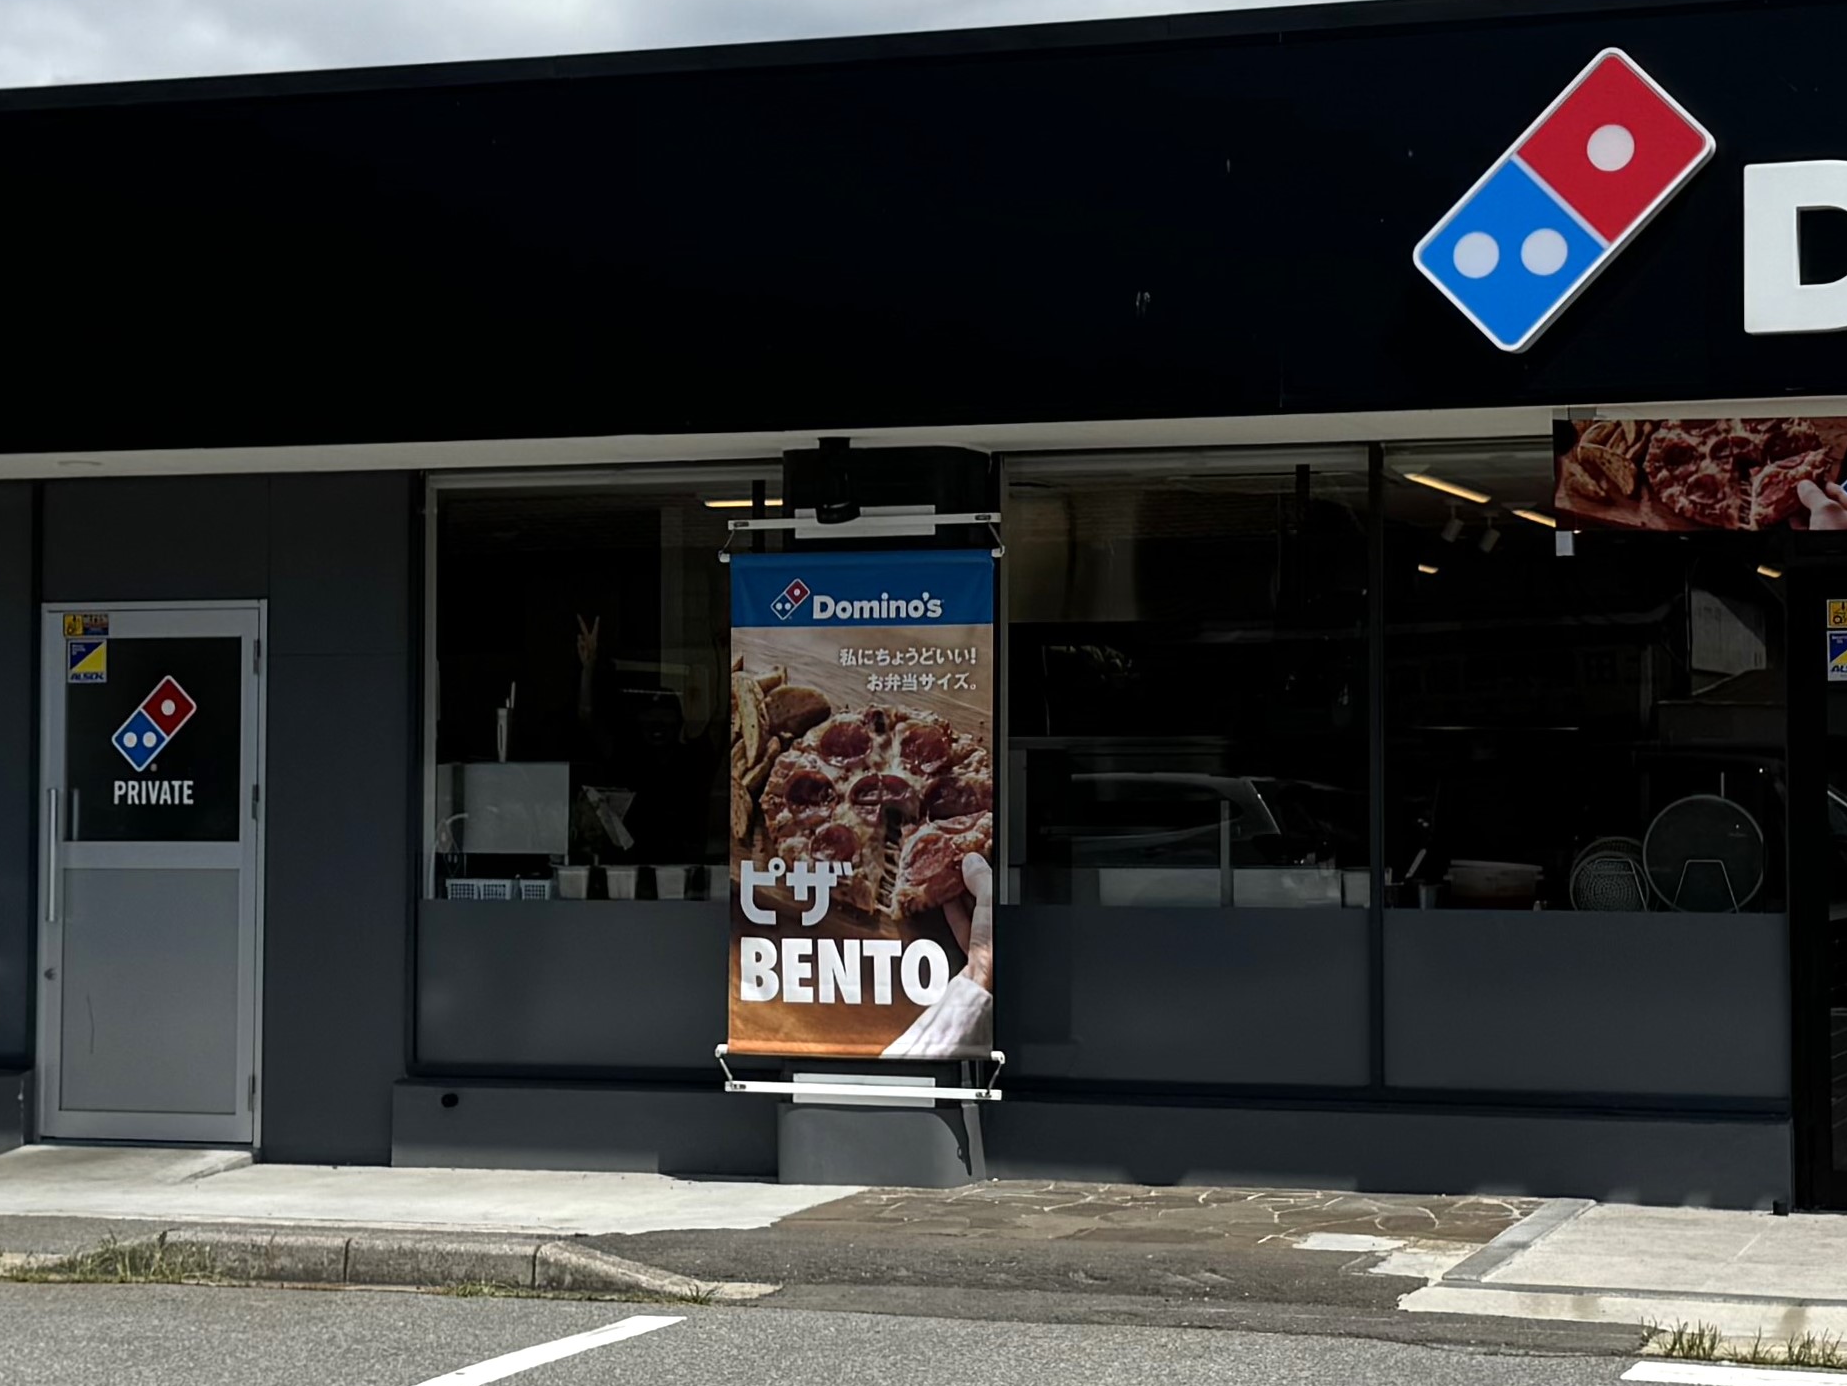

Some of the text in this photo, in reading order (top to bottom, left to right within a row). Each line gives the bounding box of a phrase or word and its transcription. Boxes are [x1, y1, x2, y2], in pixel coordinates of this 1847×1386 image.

[812, 592, 943, 620] Domino's
[839, 647, 977, 666] 私にちょうどいい!
[866, 673, 977, 691] お弁当サイズ。
[114, 780, 194, 805] PRIVATE
[740, 857, 854, 926] ピザ
[740, 937, 950, 1006] BENTO
